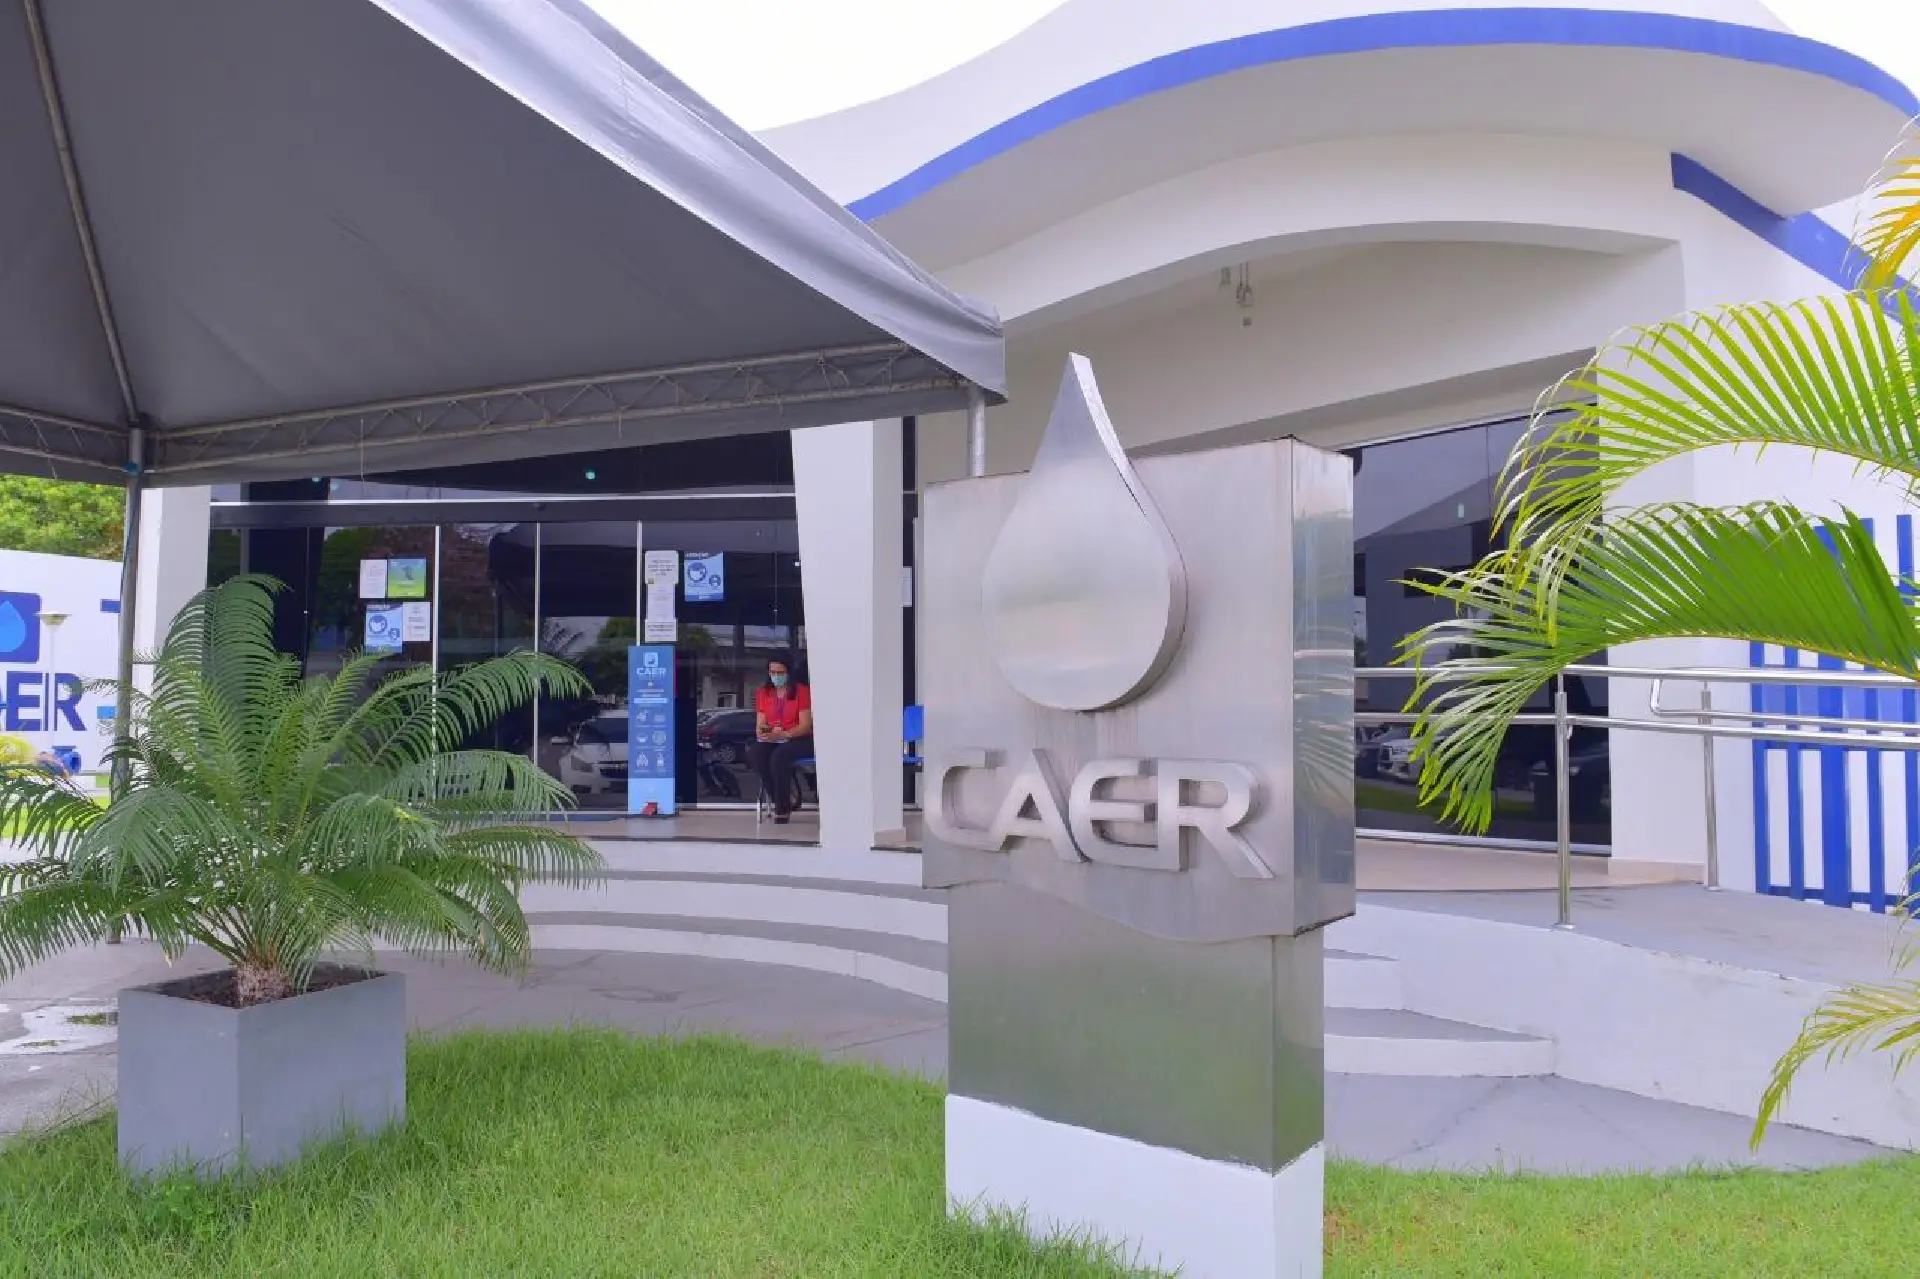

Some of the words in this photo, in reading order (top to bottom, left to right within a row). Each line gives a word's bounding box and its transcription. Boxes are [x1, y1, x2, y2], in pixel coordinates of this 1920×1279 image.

[0, 671, 87, 731] ER
[636, 667, 667, 677] CAER
[923, 747, 1274, 879] CAER
